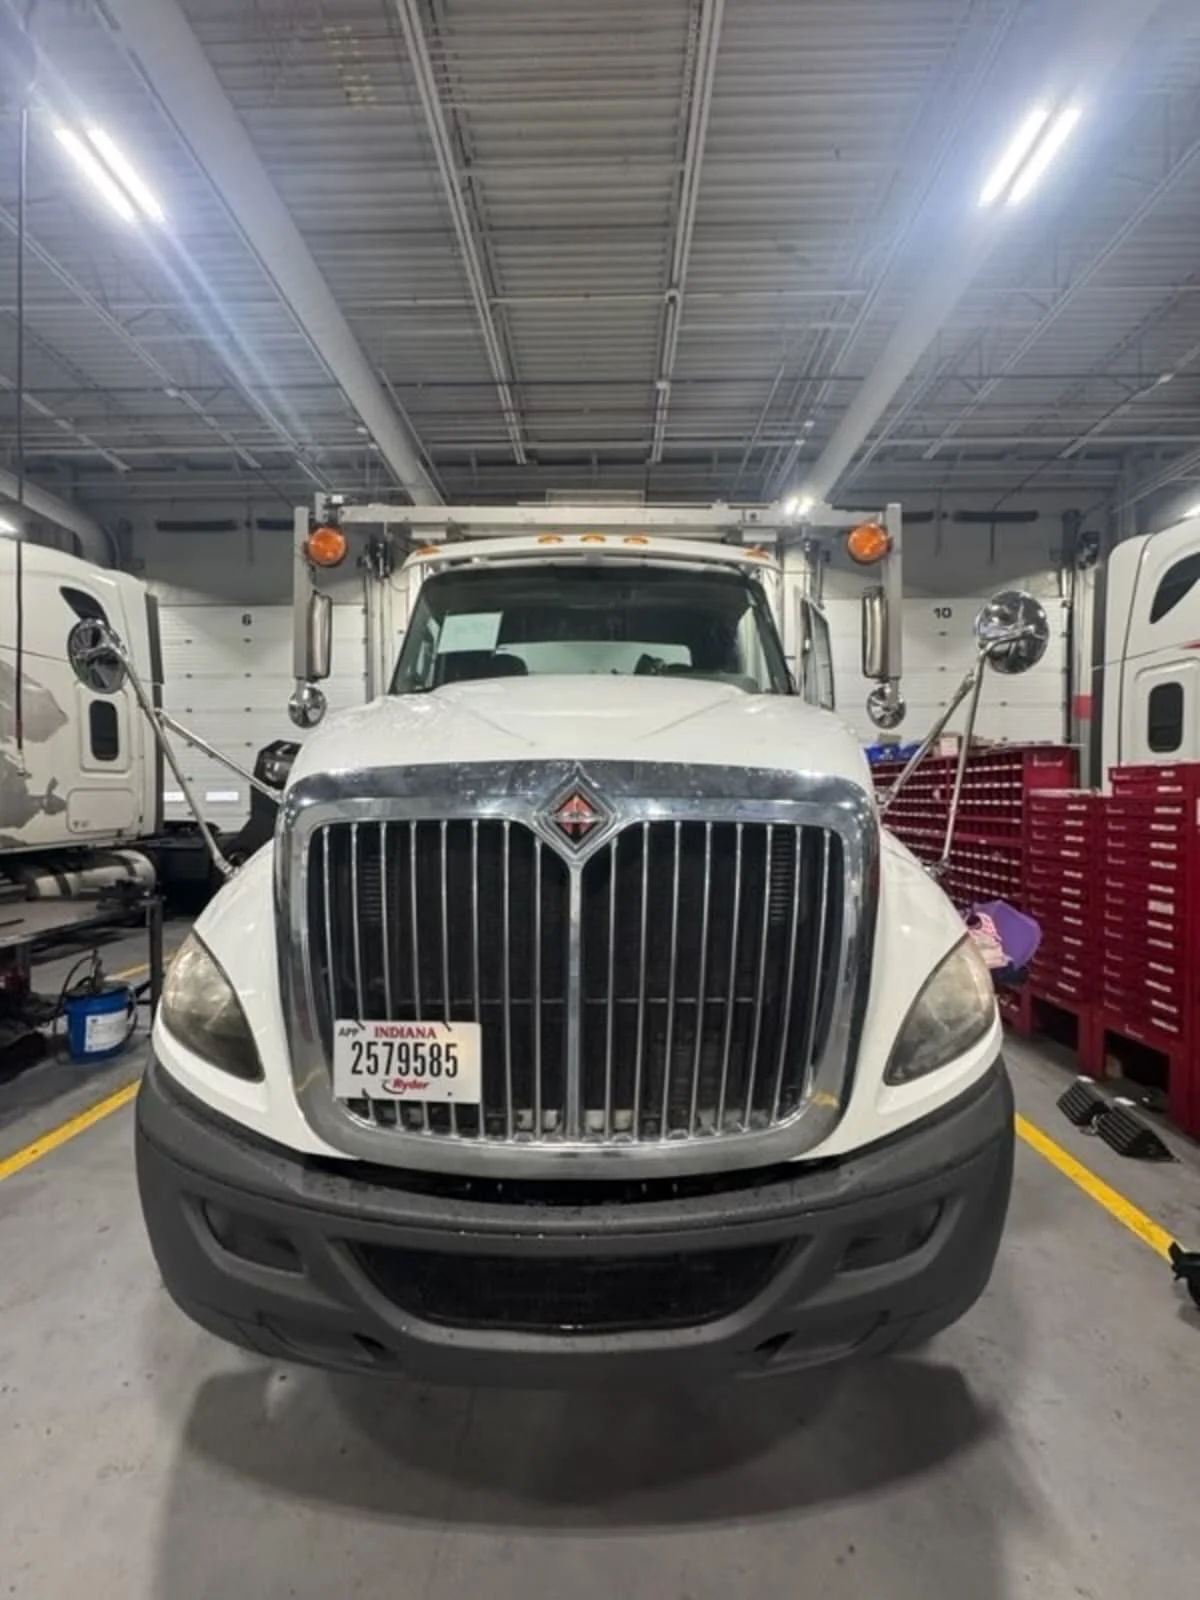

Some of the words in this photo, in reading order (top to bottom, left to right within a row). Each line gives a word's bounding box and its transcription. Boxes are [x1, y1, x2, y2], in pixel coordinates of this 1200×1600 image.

[241, 613, 252, 626] 6
[933, 607, 953, 619] 10
[338, 1027, 359, 1037] APP
[374, 1026, 437, 1039] INDIANA
[351, 1040, 458, 1078] 2579585
[391, 1078, 430, 1092] Ryder
